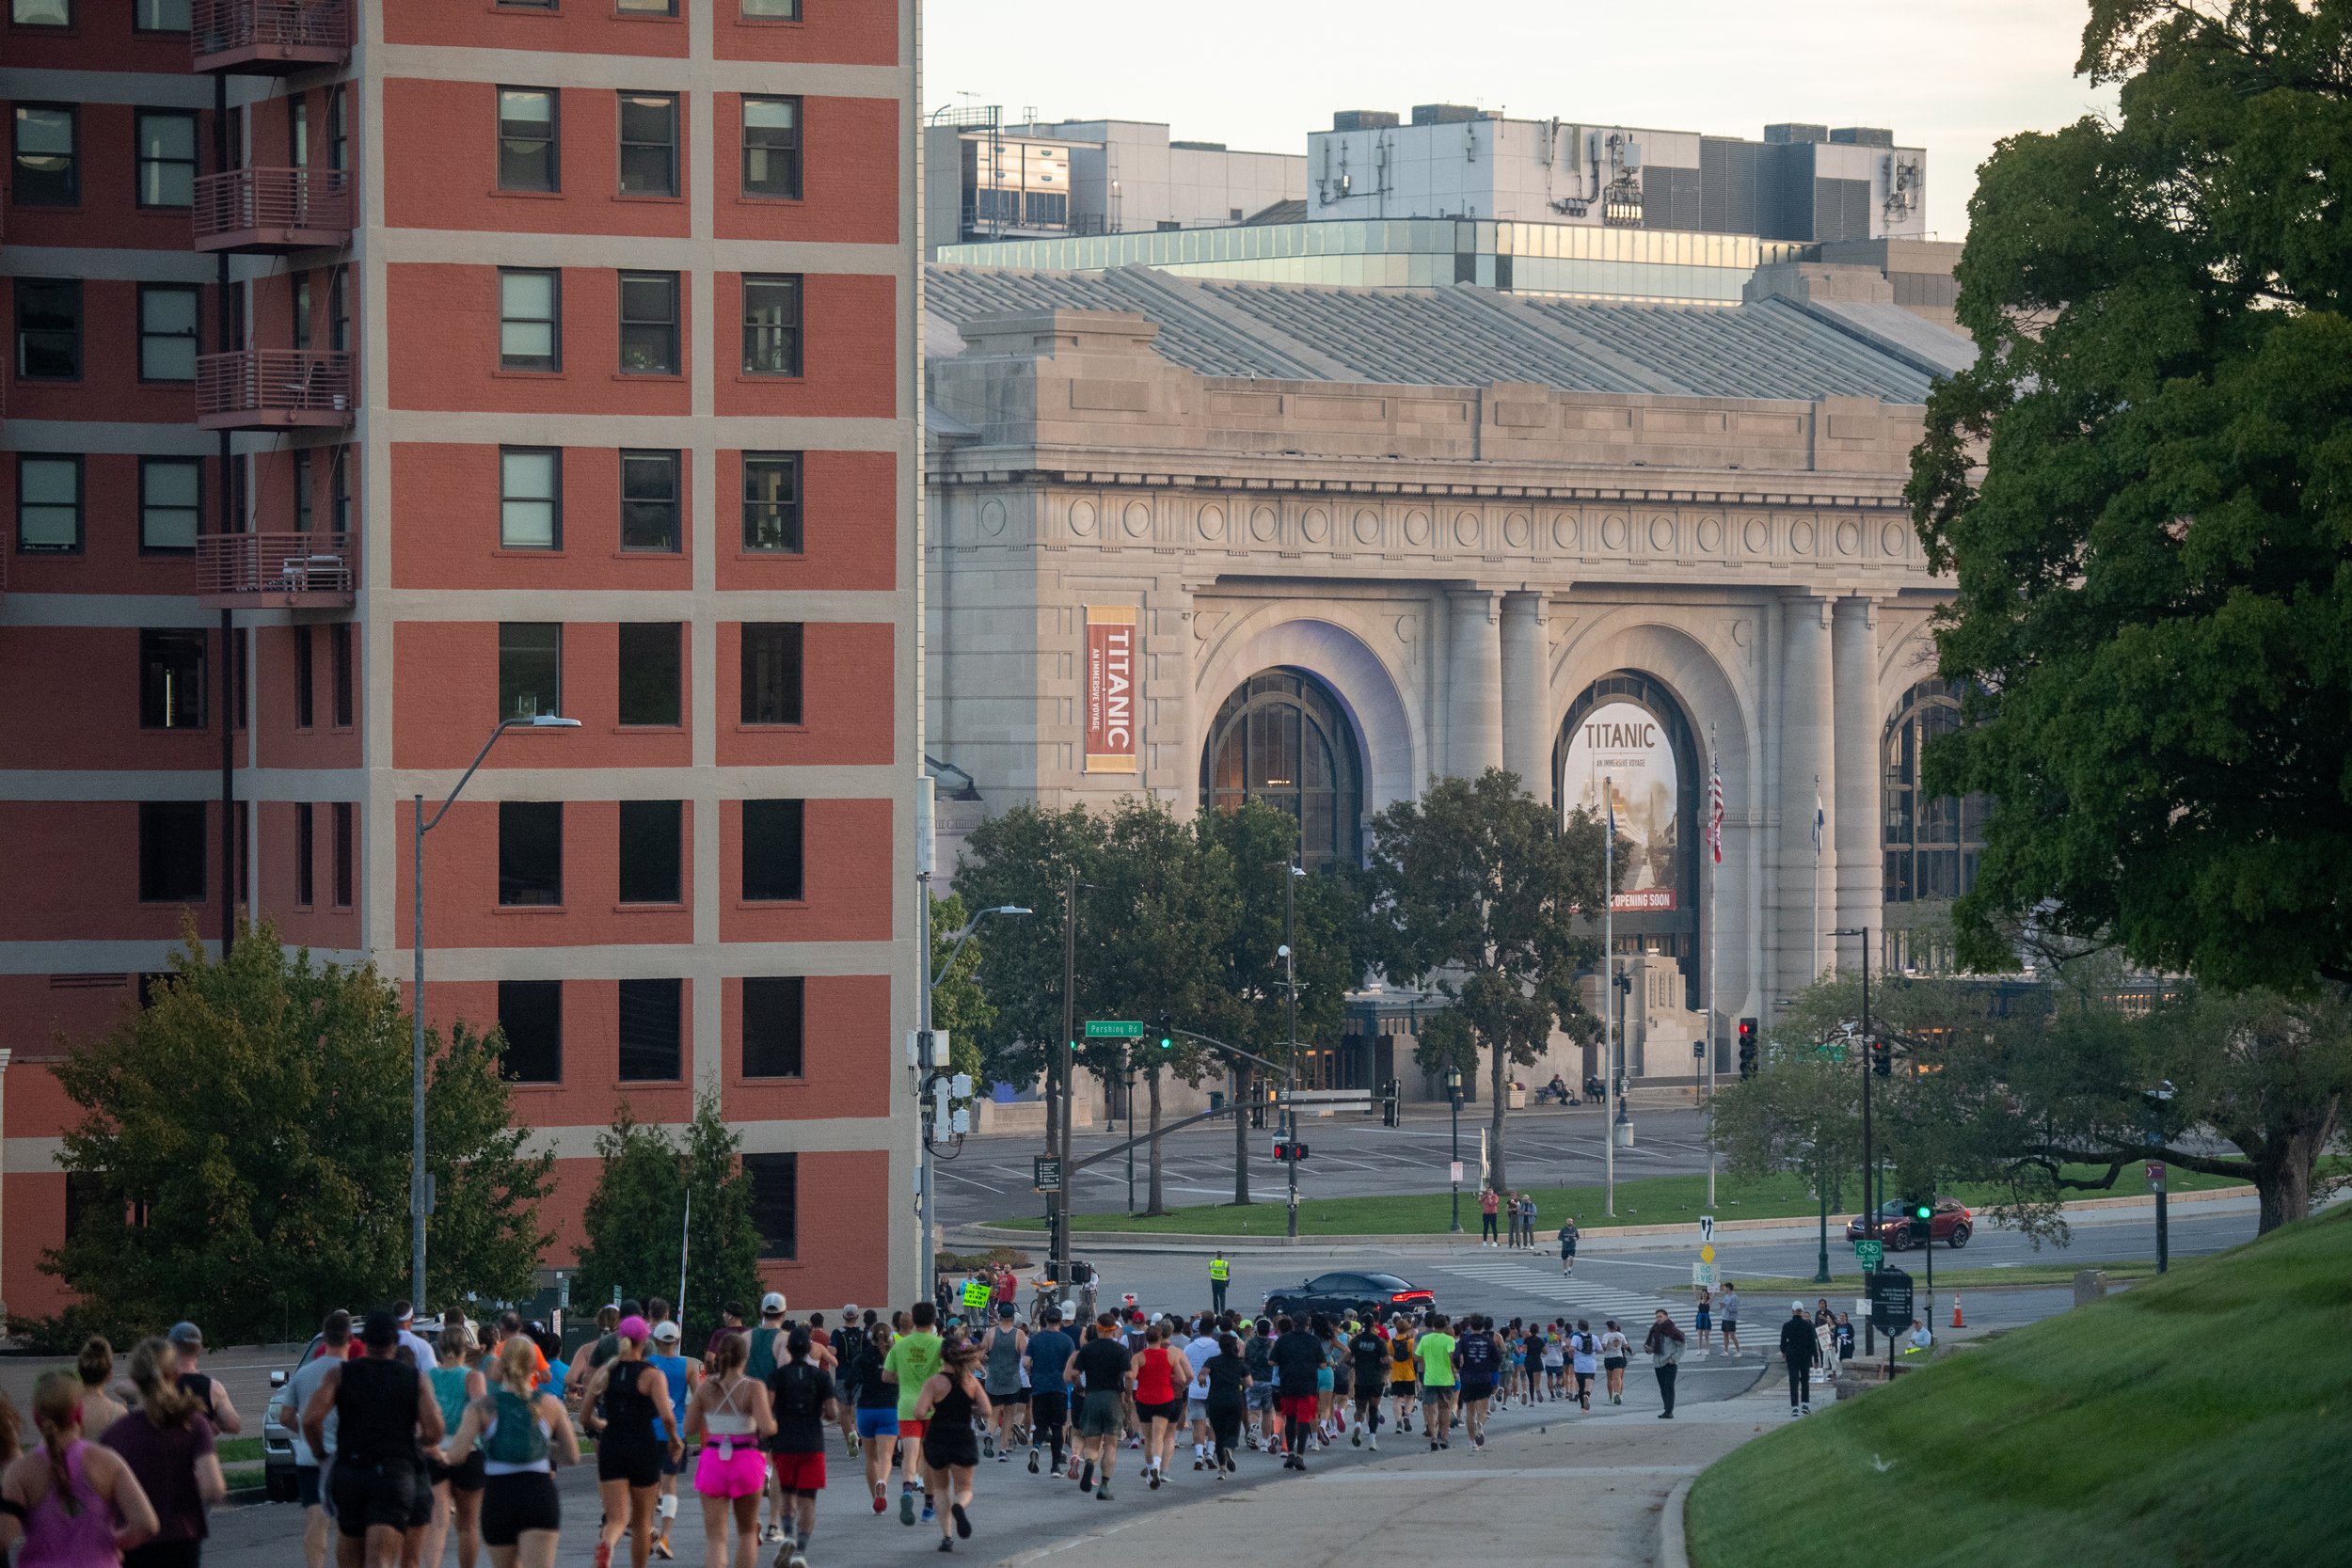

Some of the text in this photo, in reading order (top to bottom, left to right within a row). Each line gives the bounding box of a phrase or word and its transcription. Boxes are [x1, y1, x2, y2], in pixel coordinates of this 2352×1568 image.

[1092, 648, 1100, 659] AN
[1108, 630, 1129, 749] TITANIC
[1585, 723, 1656, 749] TITANIC
[1596, 758, 1645, 768] AN IMMERSIVE VOYAGE
[1614, 894, 1648, 908] OPENING
[1649, 893, 1670, 907] SOON
[1091, 1024, 1137, 1036] Pershing Rd
